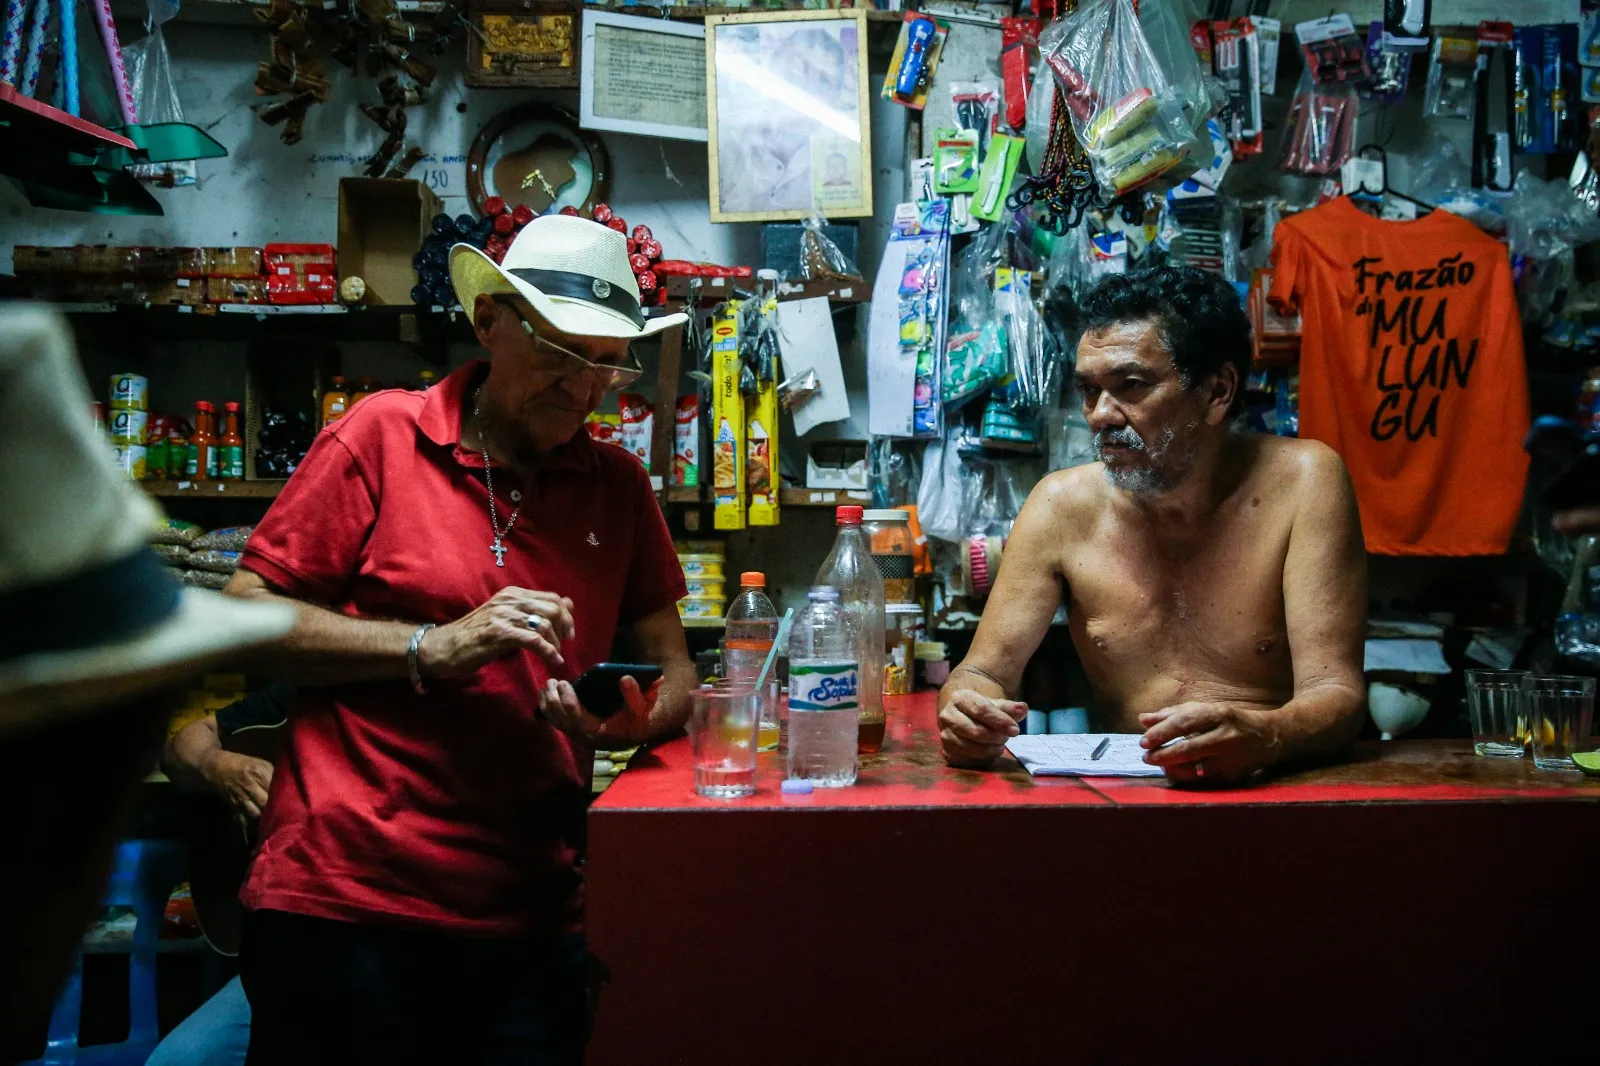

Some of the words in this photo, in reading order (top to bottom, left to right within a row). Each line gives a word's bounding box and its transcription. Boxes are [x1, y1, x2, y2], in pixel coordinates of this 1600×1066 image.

[1353, 252, 1475, 294] Frazão
[1371, 296, 1449, 348] MU
[1378, 338, 1478, 392] LUN
[1370, 391, 1441, 442] GU
